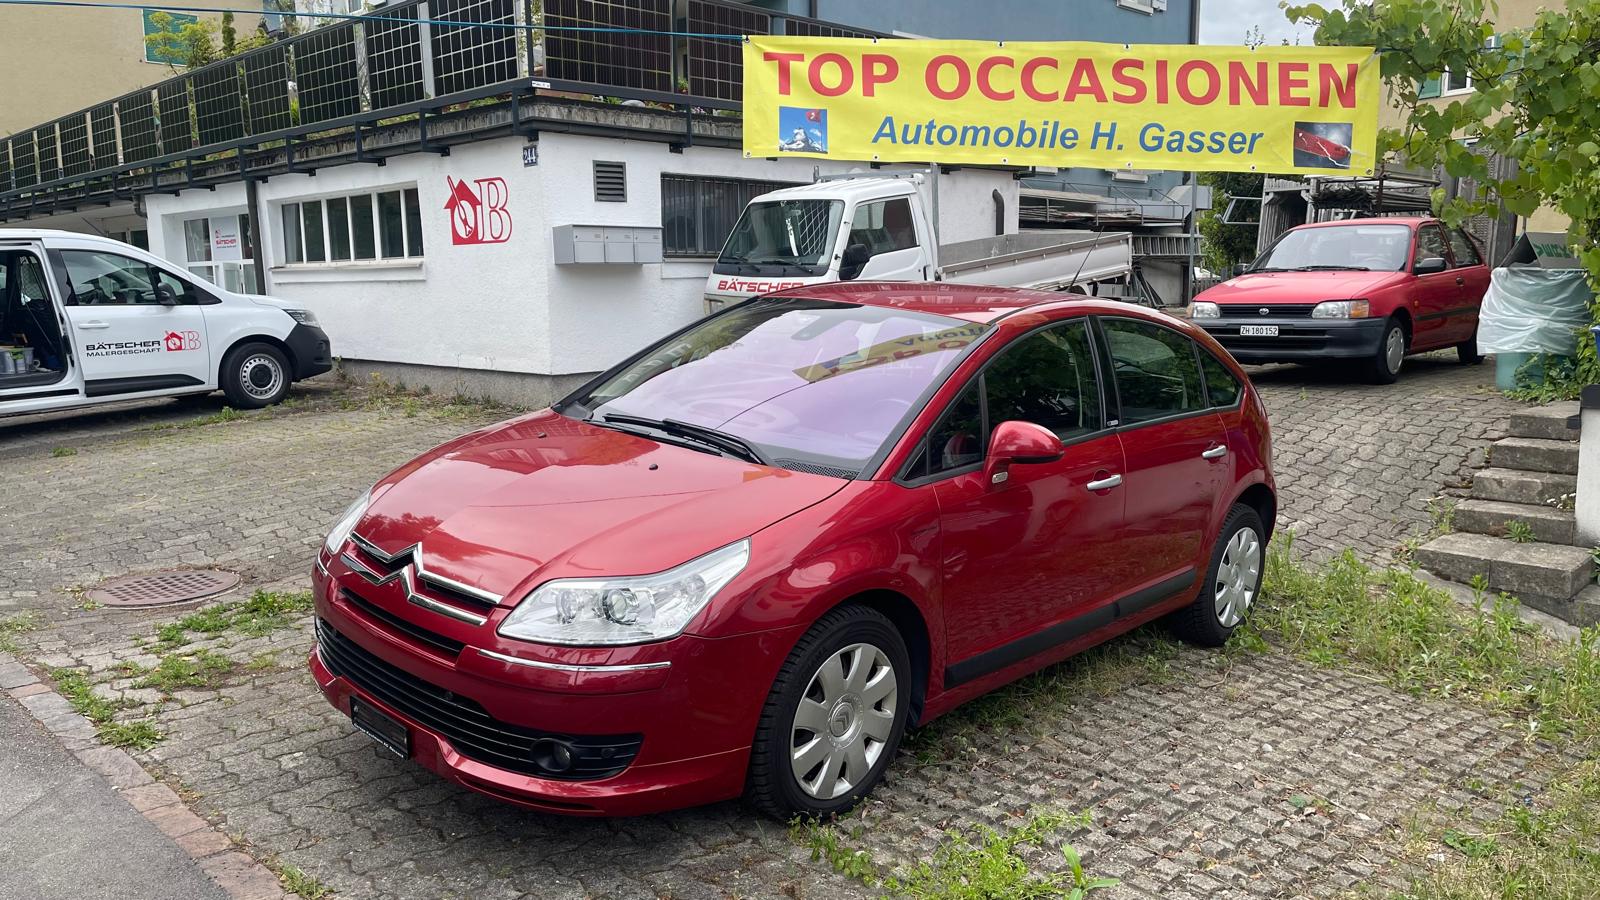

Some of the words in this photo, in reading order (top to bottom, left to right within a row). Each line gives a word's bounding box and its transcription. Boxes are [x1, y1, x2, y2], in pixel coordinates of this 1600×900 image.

[763, 52, 899, 97] TOP
[925, 55, 1359, 108] OCCASIONEN
[872, 116, 1079, 149] Automobile
[1090, 122, 1124, 150] H.
[1139, 123, 1264, 154] Gasser
[523, 148, 536, 164] 244
[86, 341, 161, 351] BÄTSCHER
[86, 348, 161, 357] MALERGESCHÄFT
